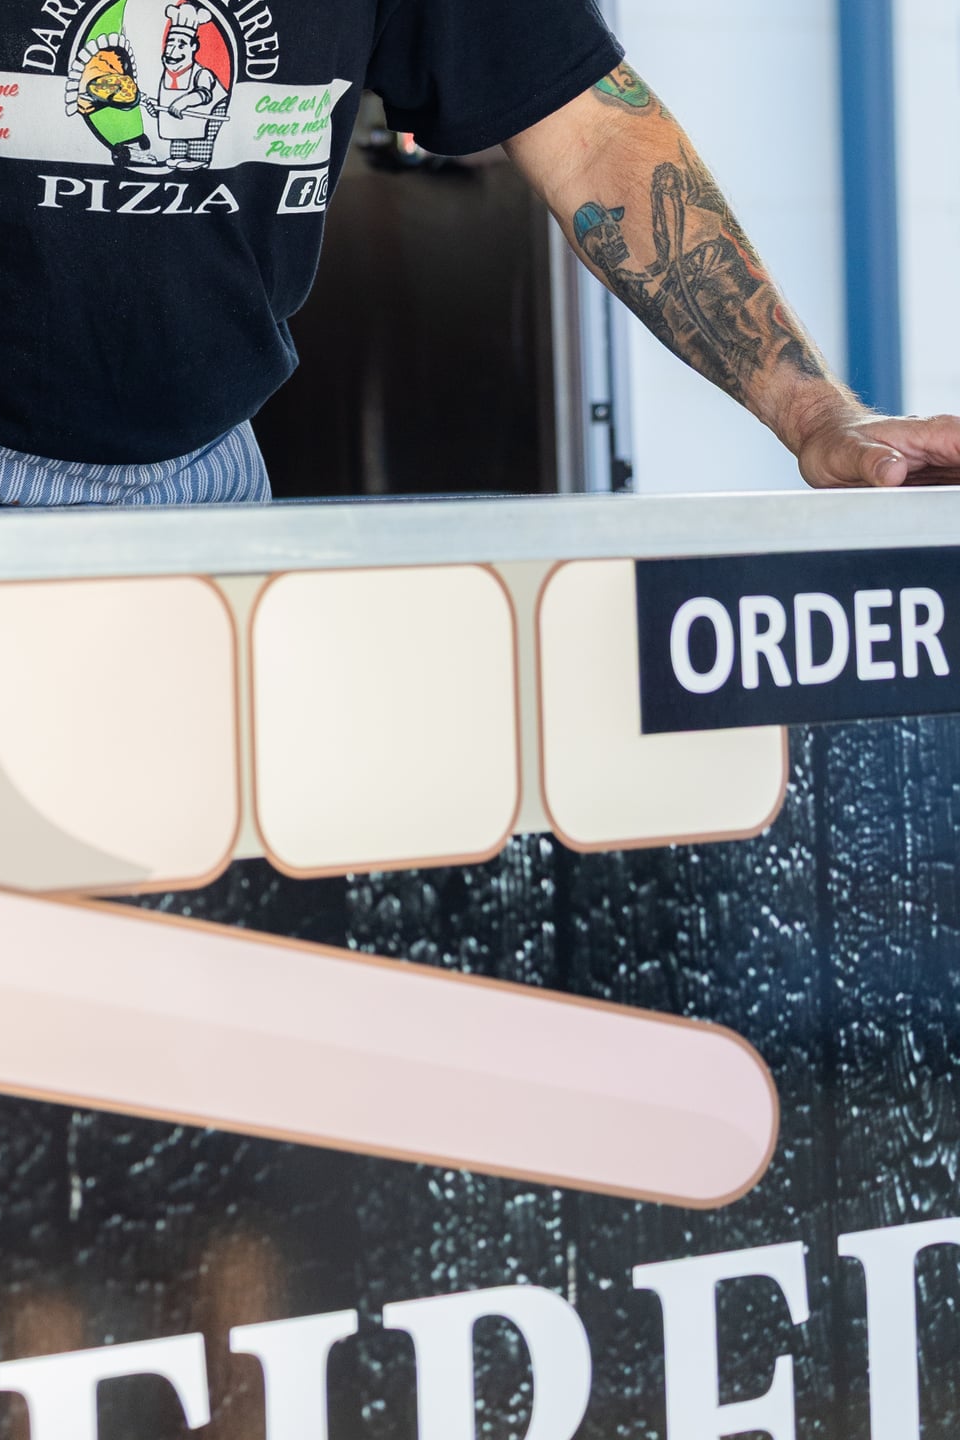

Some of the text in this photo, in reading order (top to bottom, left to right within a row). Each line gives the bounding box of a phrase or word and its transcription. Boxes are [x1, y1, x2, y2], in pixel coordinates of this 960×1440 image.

[255, 89, 331, 118] Call us fo
[253, 114, 330, 140] your next
[265, 136, 323, 159] Party!
[37, 175, 240, 214] PIZZA
[670, 587, 950, 694] ORDER
